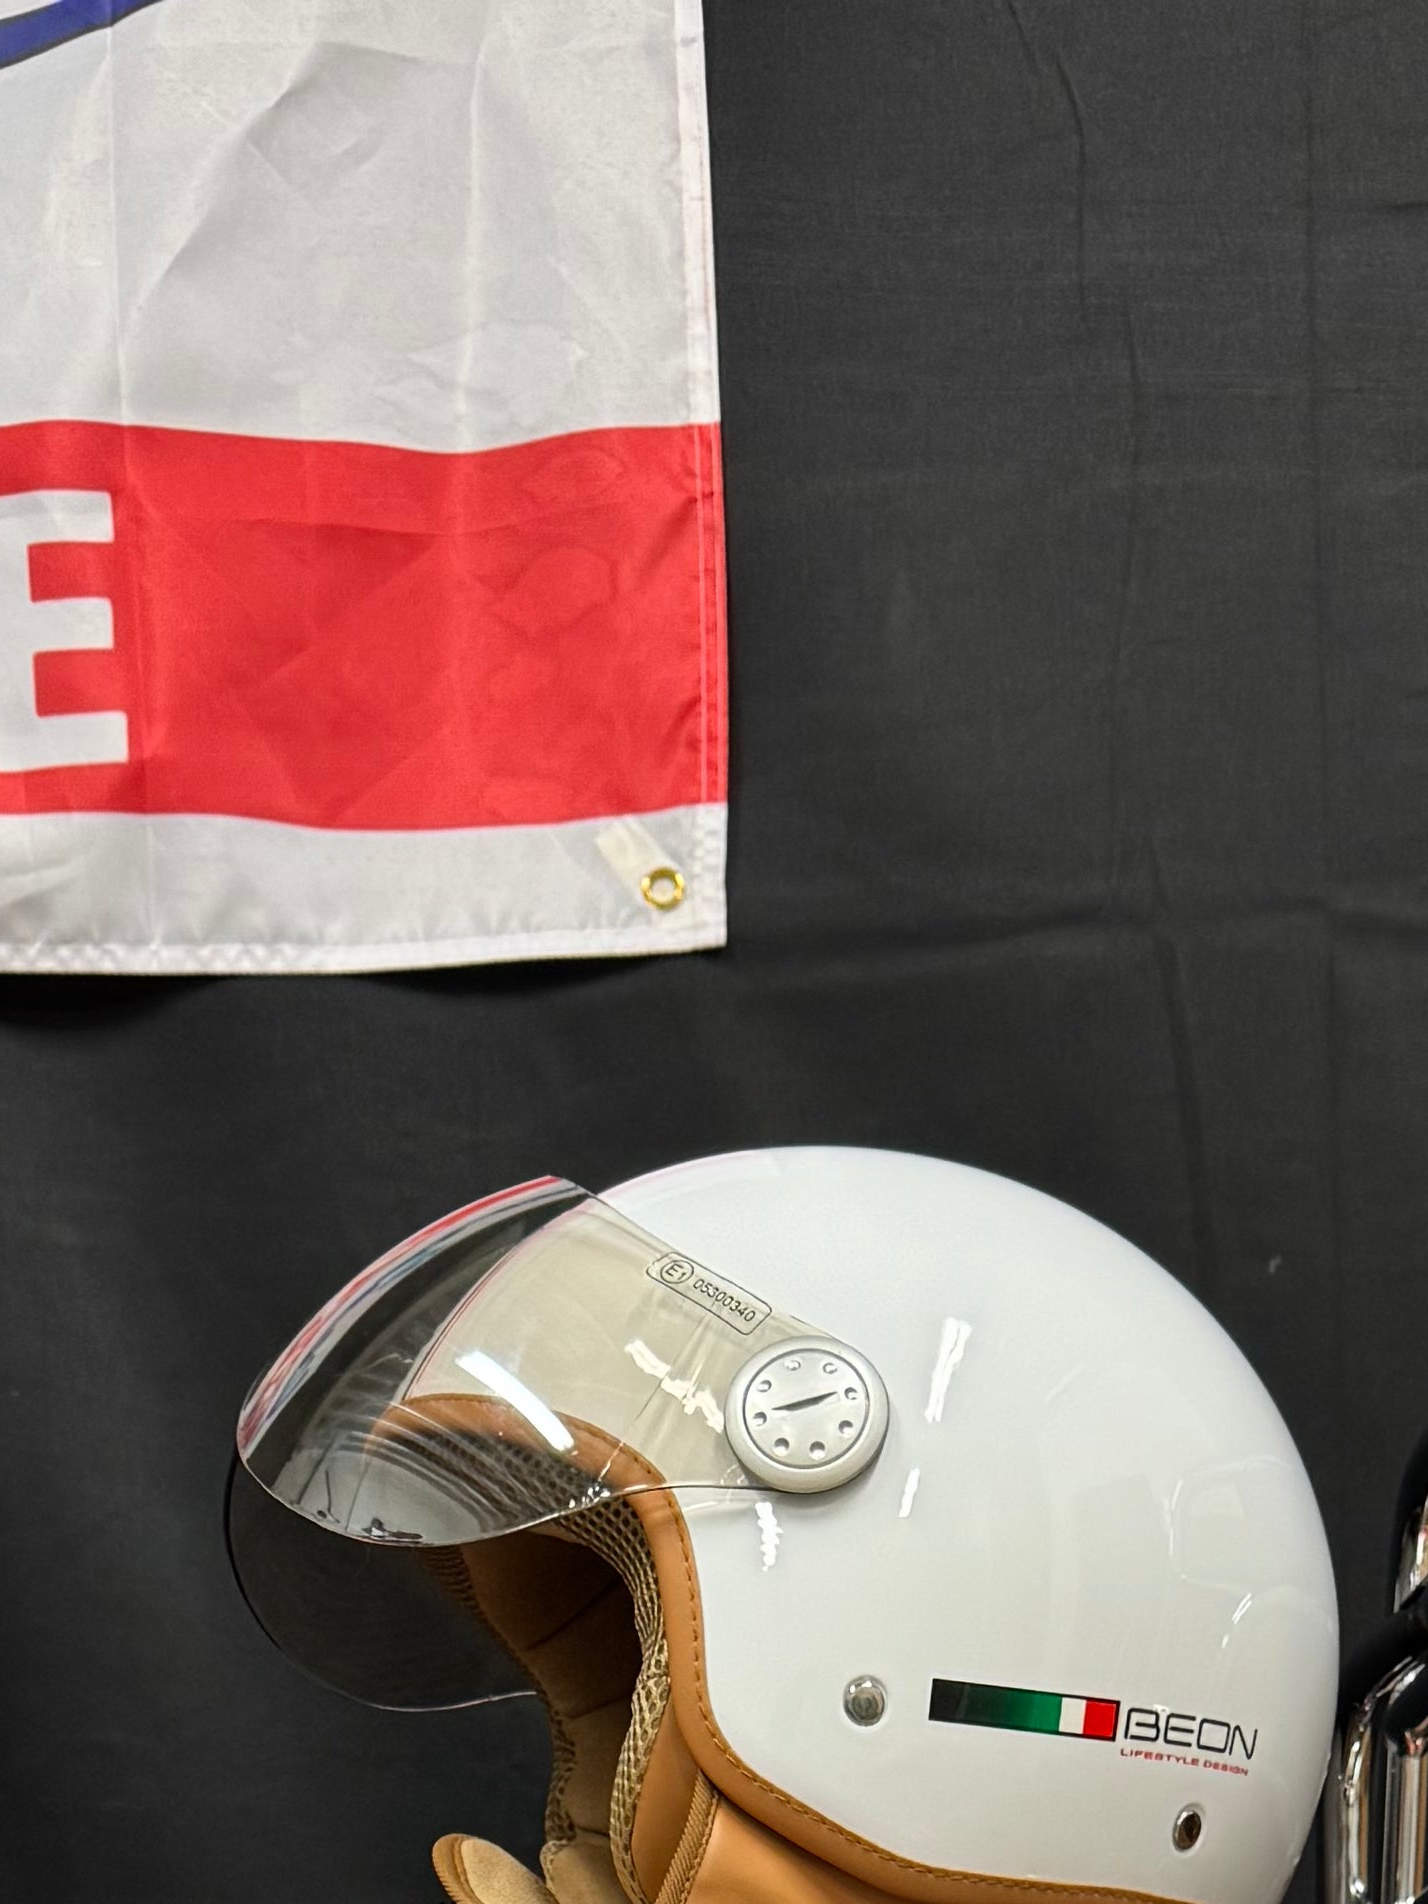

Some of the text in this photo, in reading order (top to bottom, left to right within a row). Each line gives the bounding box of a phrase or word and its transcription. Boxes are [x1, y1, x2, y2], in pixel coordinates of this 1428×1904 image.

[1123, 1706, 1258, 1760] BEON
[1120, 1748, 1249, 1777] LIFESTYLE DESIGN
